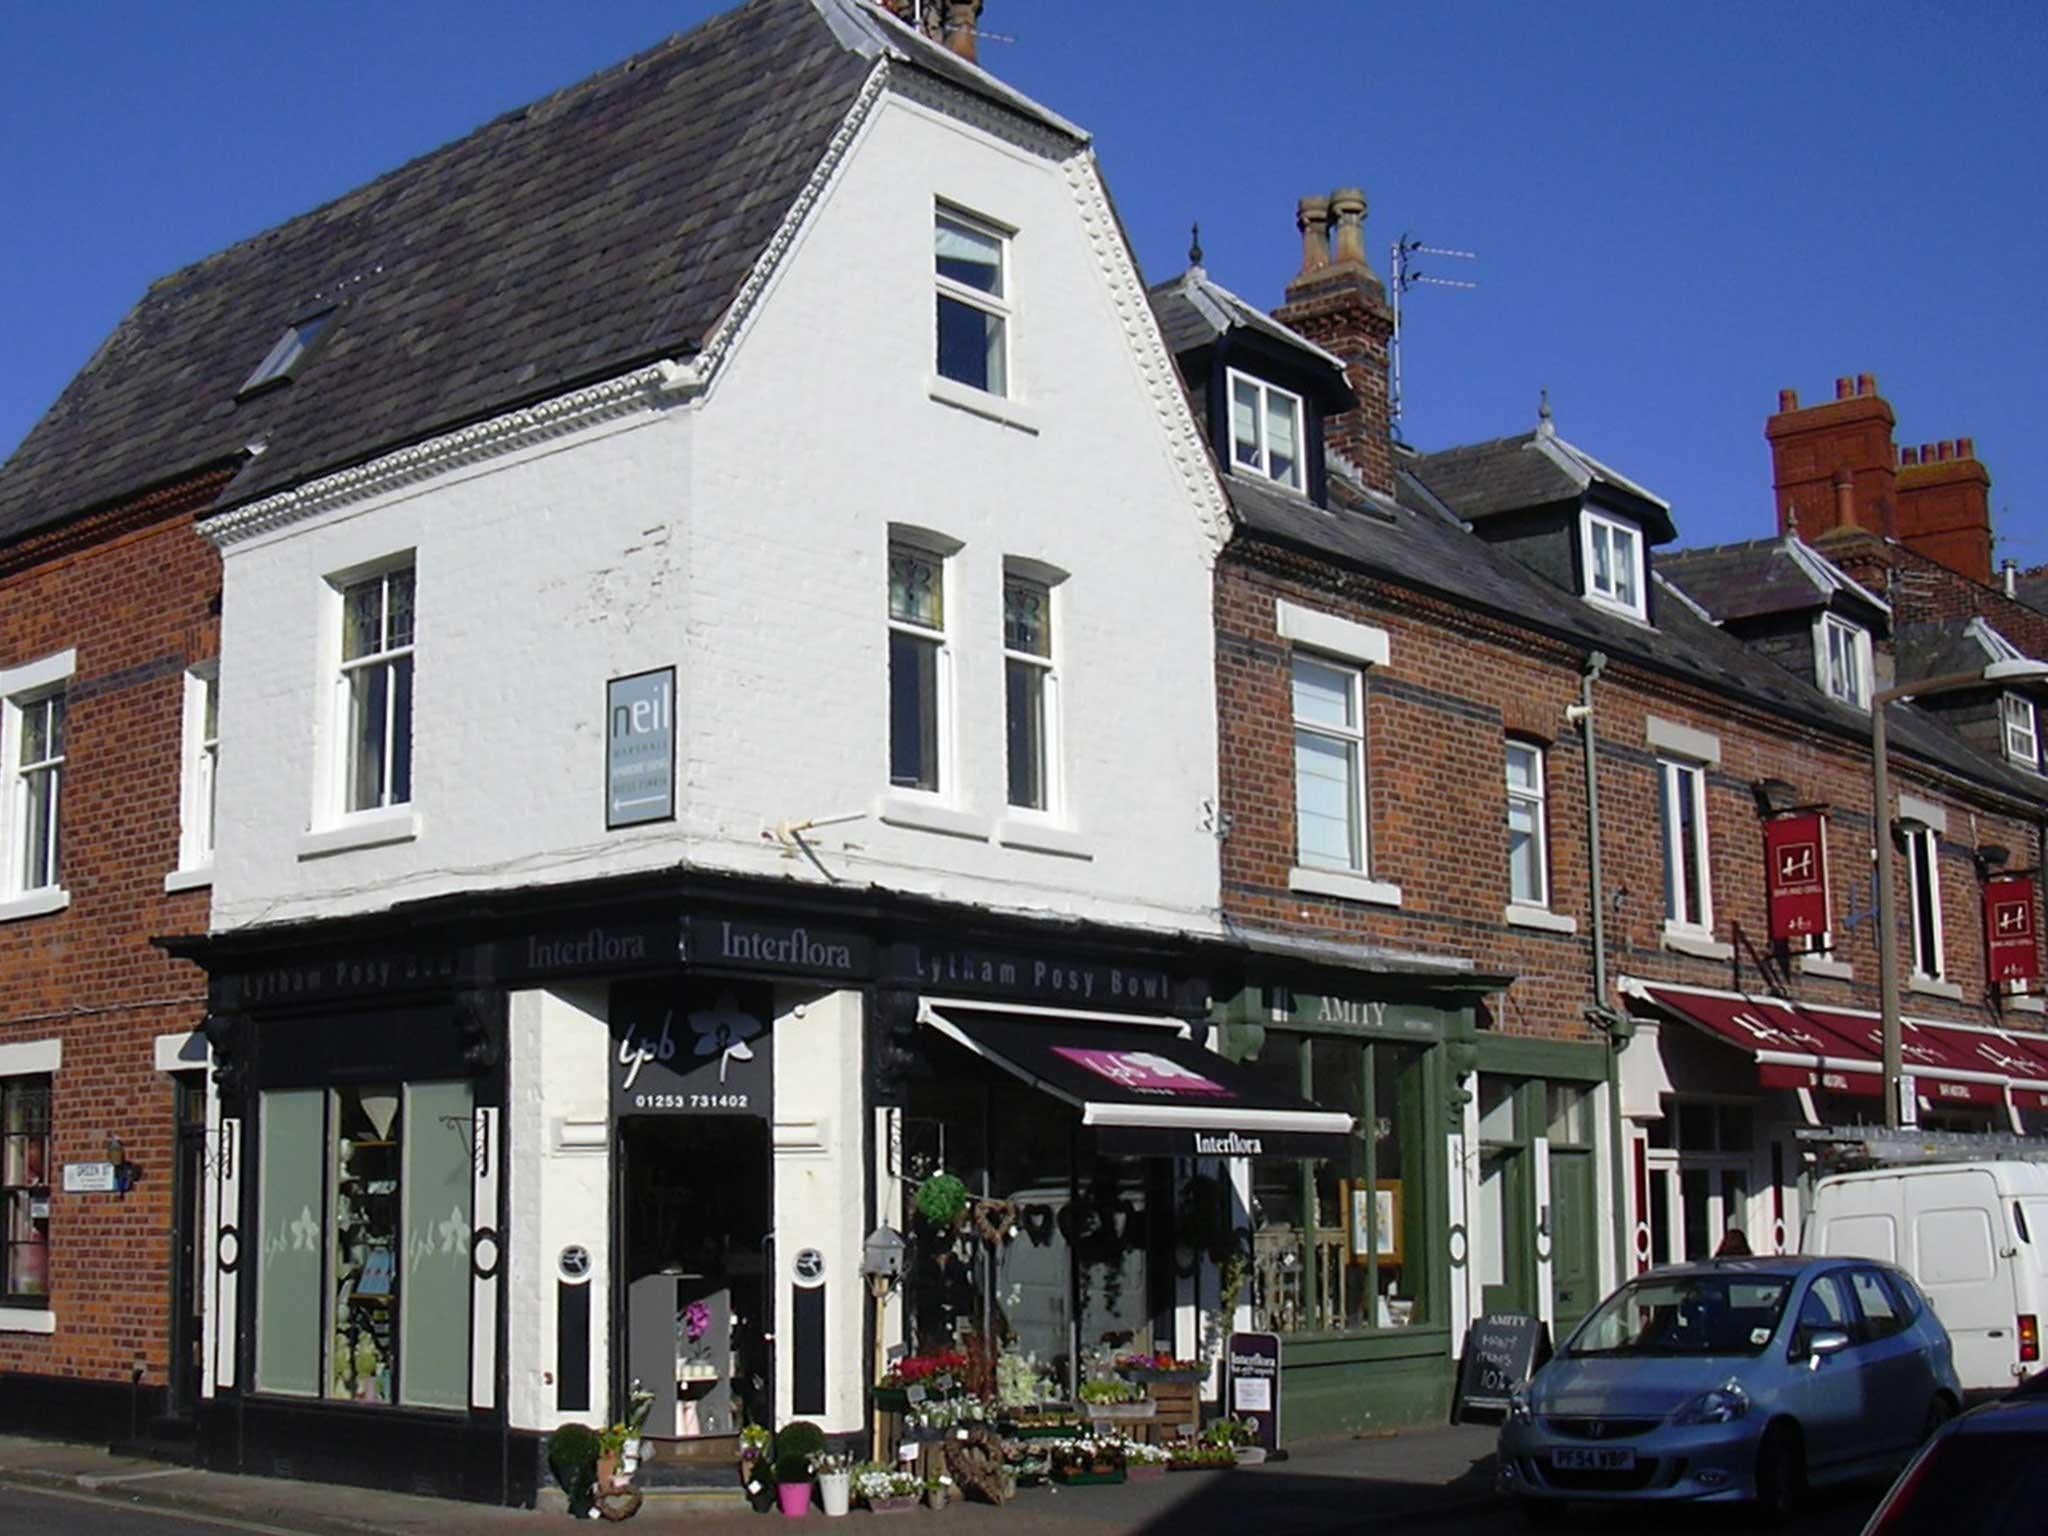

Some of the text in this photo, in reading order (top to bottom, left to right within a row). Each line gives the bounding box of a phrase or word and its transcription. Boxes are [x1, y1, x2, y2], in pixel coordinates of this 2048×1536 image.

[613, 681, 669, 738] neil
[1782, 849, 1812, 877] H
[528, 929, 646, 969] Interflora
[722, 921, 851, 969] Interflora
[336, 960, 390, 987] Posy
[914, 948, 1168, 1001] Lytham Posy Bowl
[1318, 996, 1388, 1027] AMITY
[635, 1094, 749, 1108] 01253 731402
[1195, 1132, 1262, 1155] Interflora
[1488, 1314, 1528, 1327] AMITY
[1231, 1352, 1276, 1367] Interflora
